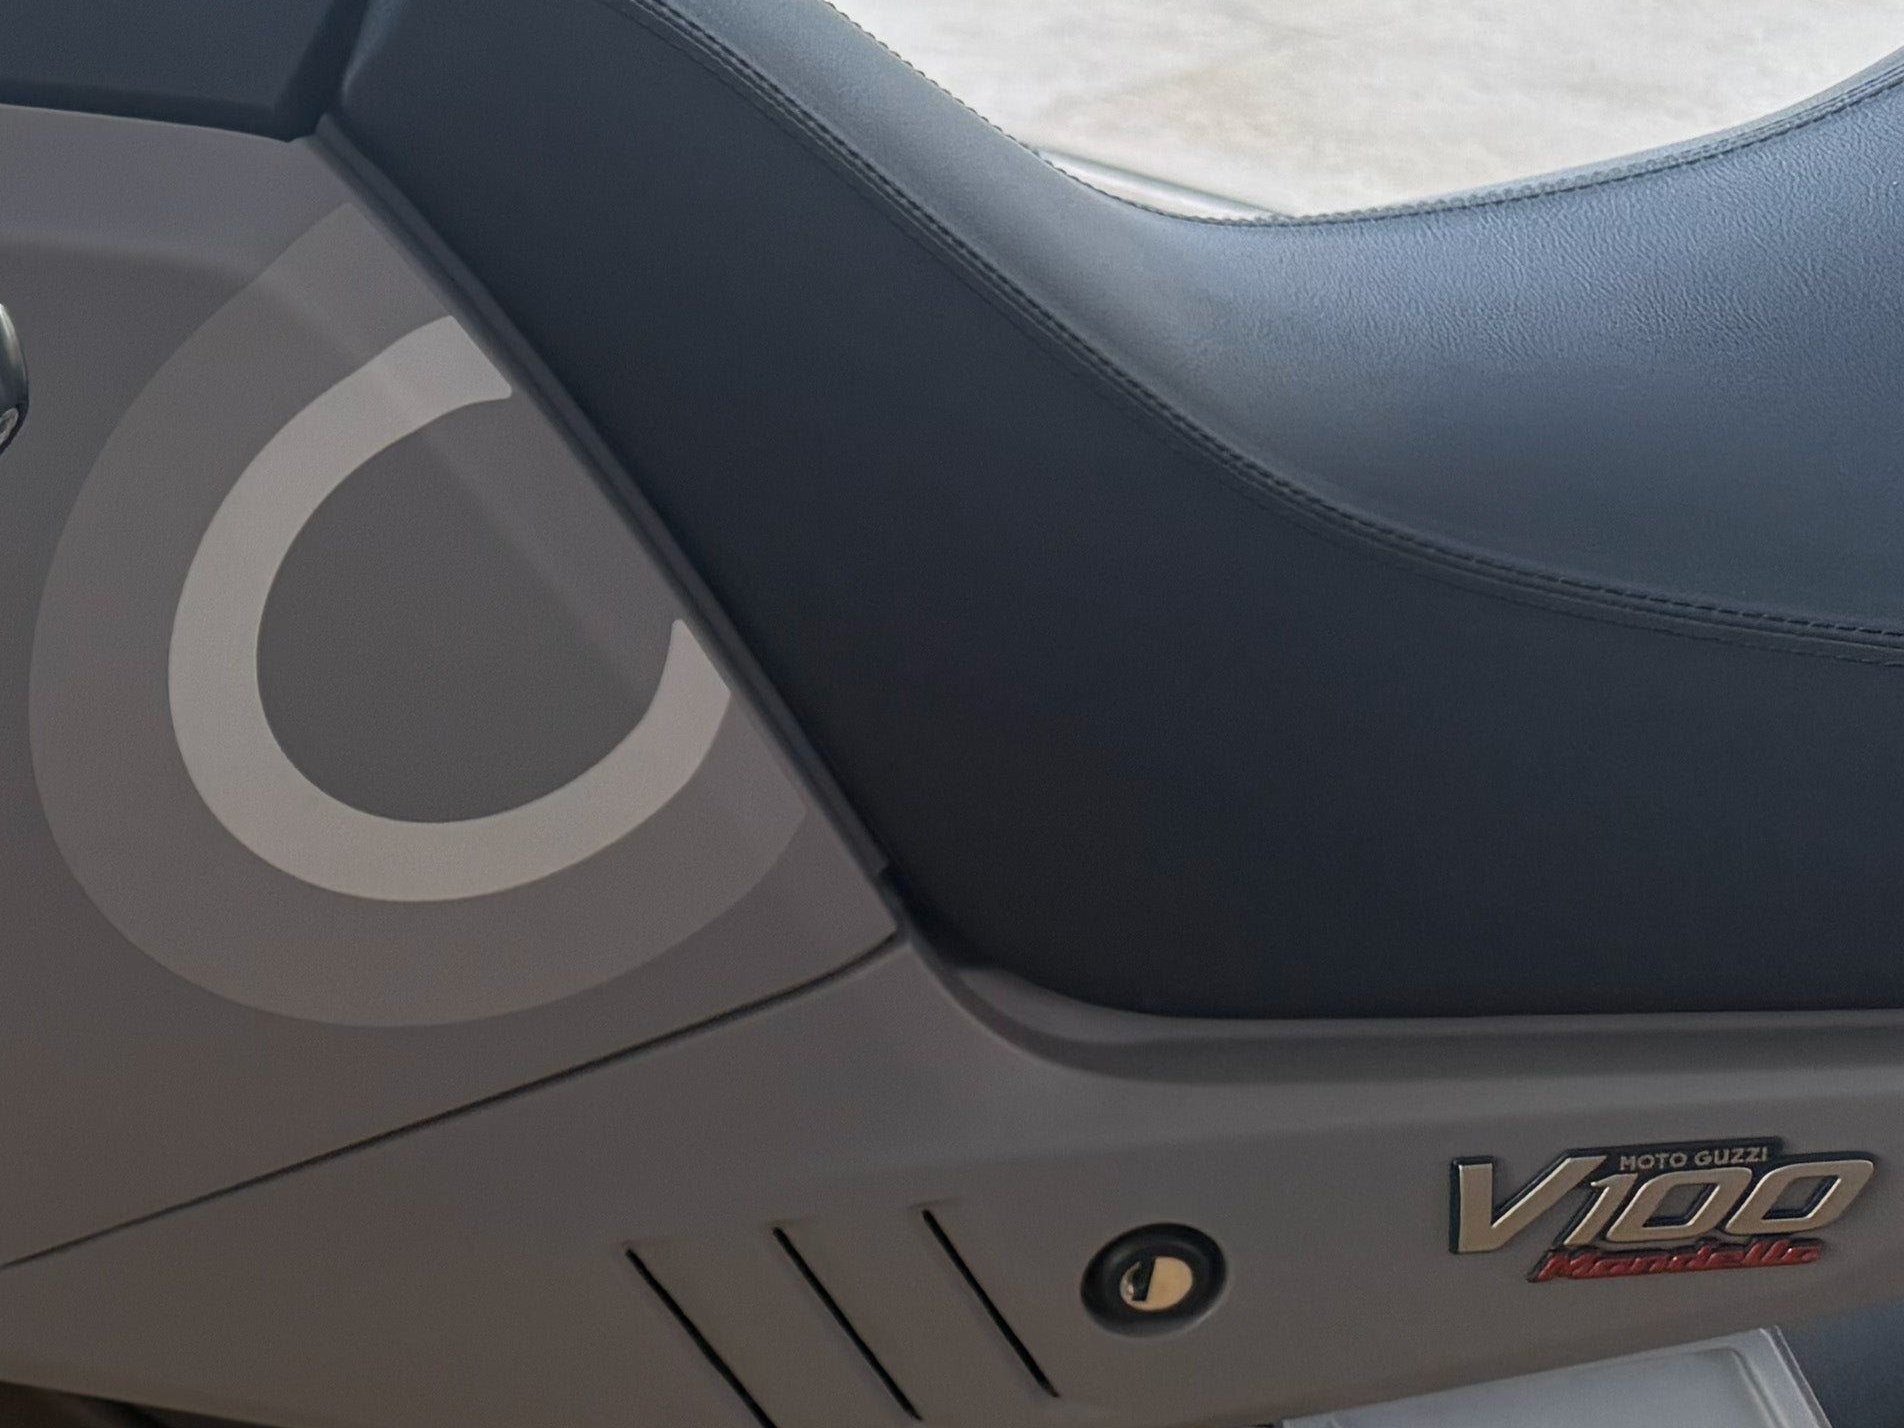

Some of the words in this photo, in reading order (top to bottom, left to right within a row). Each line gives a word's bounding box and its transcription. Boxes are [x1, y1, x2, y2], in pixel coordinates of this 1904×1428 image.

[1619, 1149, 1687, 1171] MOTO
[1694, 1146, 1768, 1166] GUZZI
[1457, 1155, 1875, 1253] V100
[1534, 1236, 1824, 1281] Mandello
